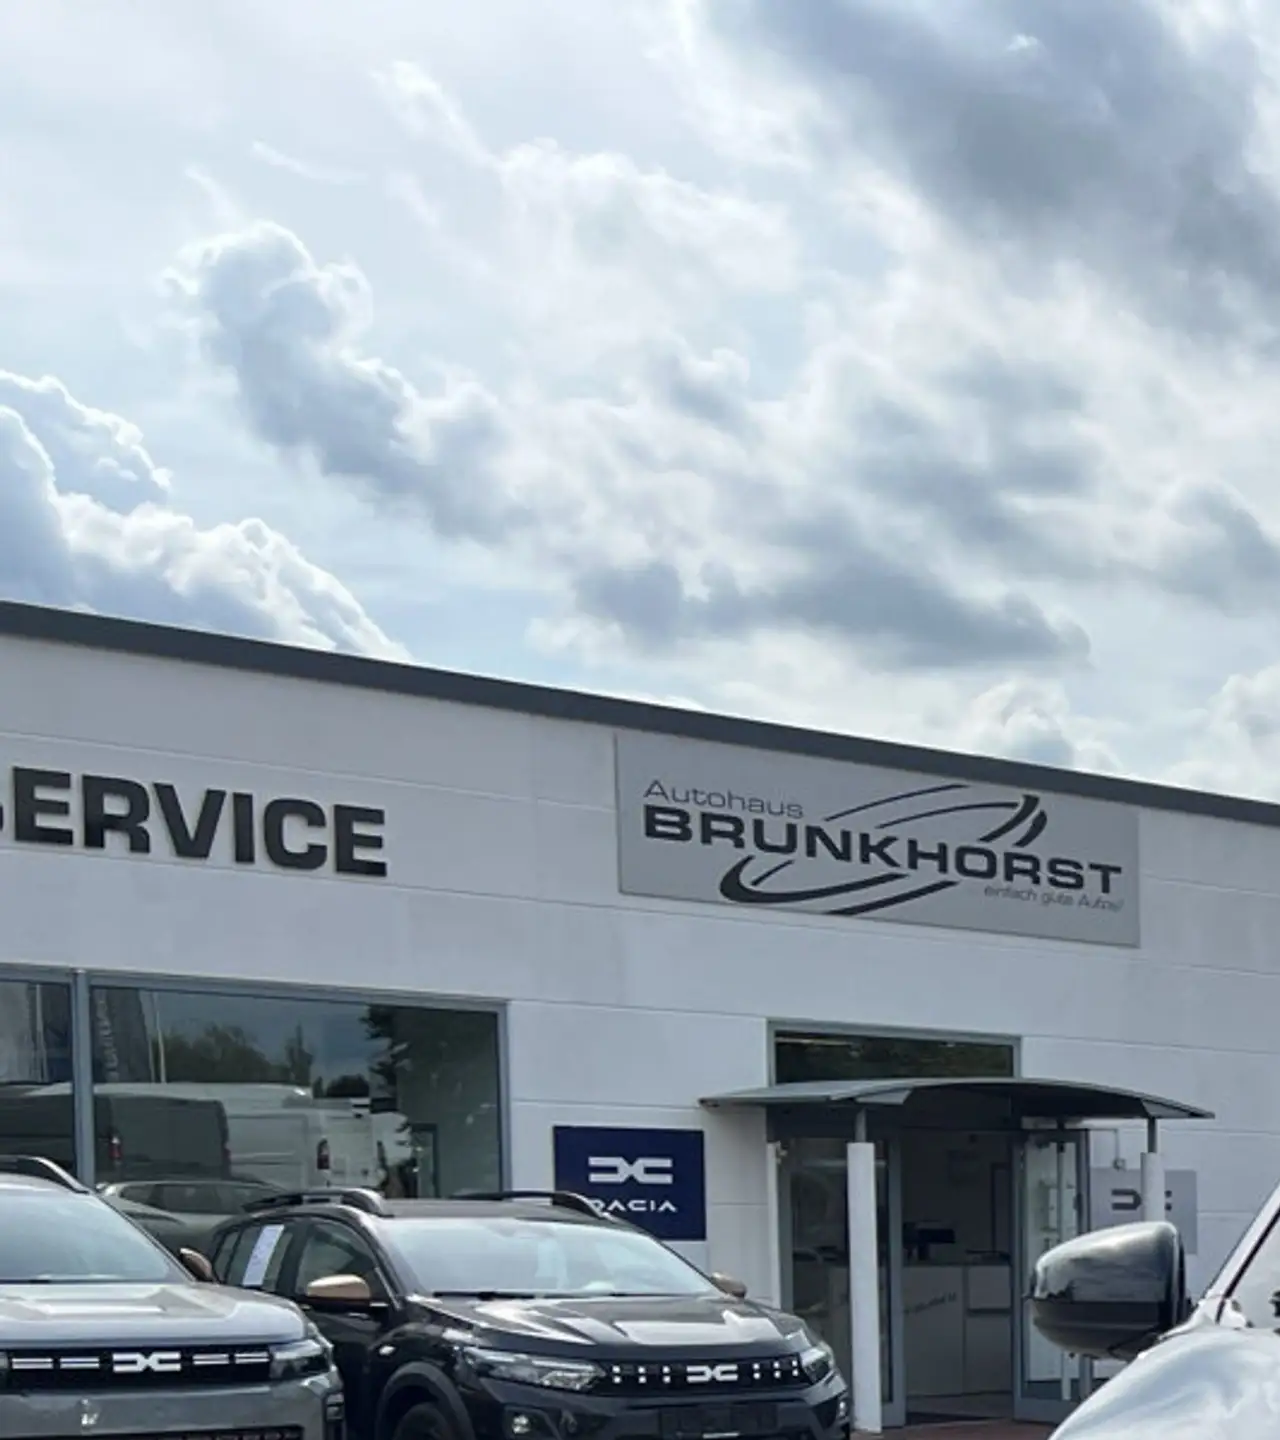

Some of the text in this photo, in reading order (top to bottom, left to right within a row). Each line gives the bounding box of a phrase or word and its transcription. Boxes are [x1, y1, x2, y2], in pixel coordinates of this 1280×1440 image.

[0, 766, 387, 877] ERVICE
[643, 780, 803, 819] Autohaus
[644, 804, 1122, 894] BRUNKHORST
